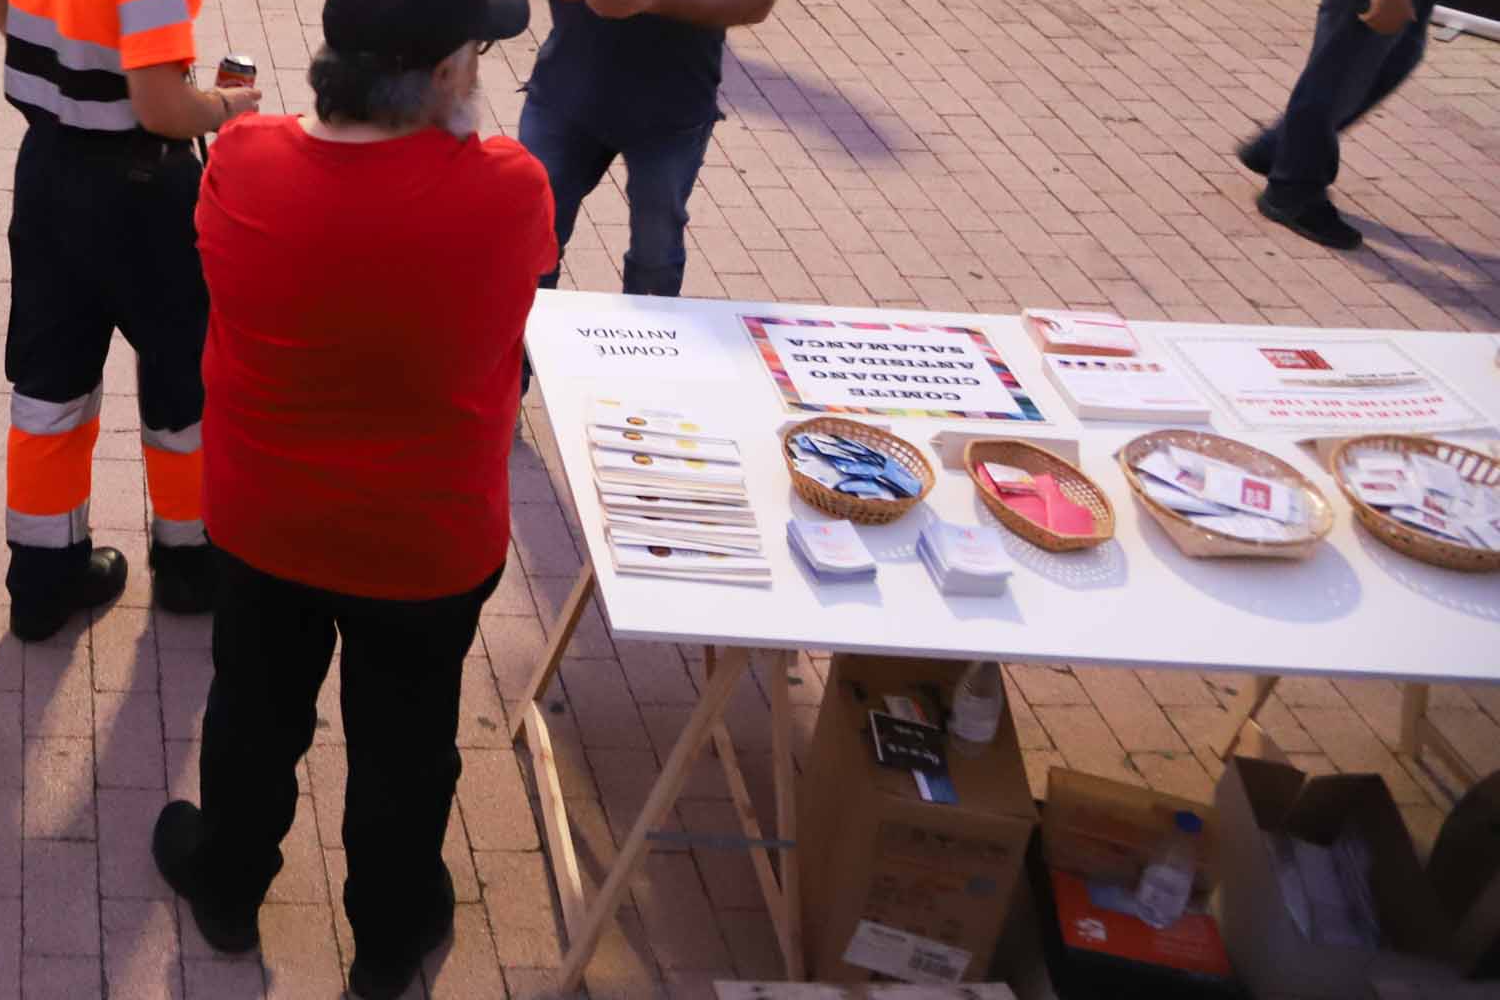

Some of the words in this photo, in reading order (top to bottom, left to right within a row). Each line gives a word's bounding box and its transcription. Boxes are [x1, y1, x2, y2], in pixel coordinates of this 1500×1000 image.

[576, 327, 677, 341] ANTISIDA
[594, 344, 680, 359] COMITÉ
[784, 338, 966, 355] SALAMANCA
[791, 353, 829, 364] DE
[835, 355, 975, 371] ANTISIDA
[808, 370, 981, 387] CIUDADANO
